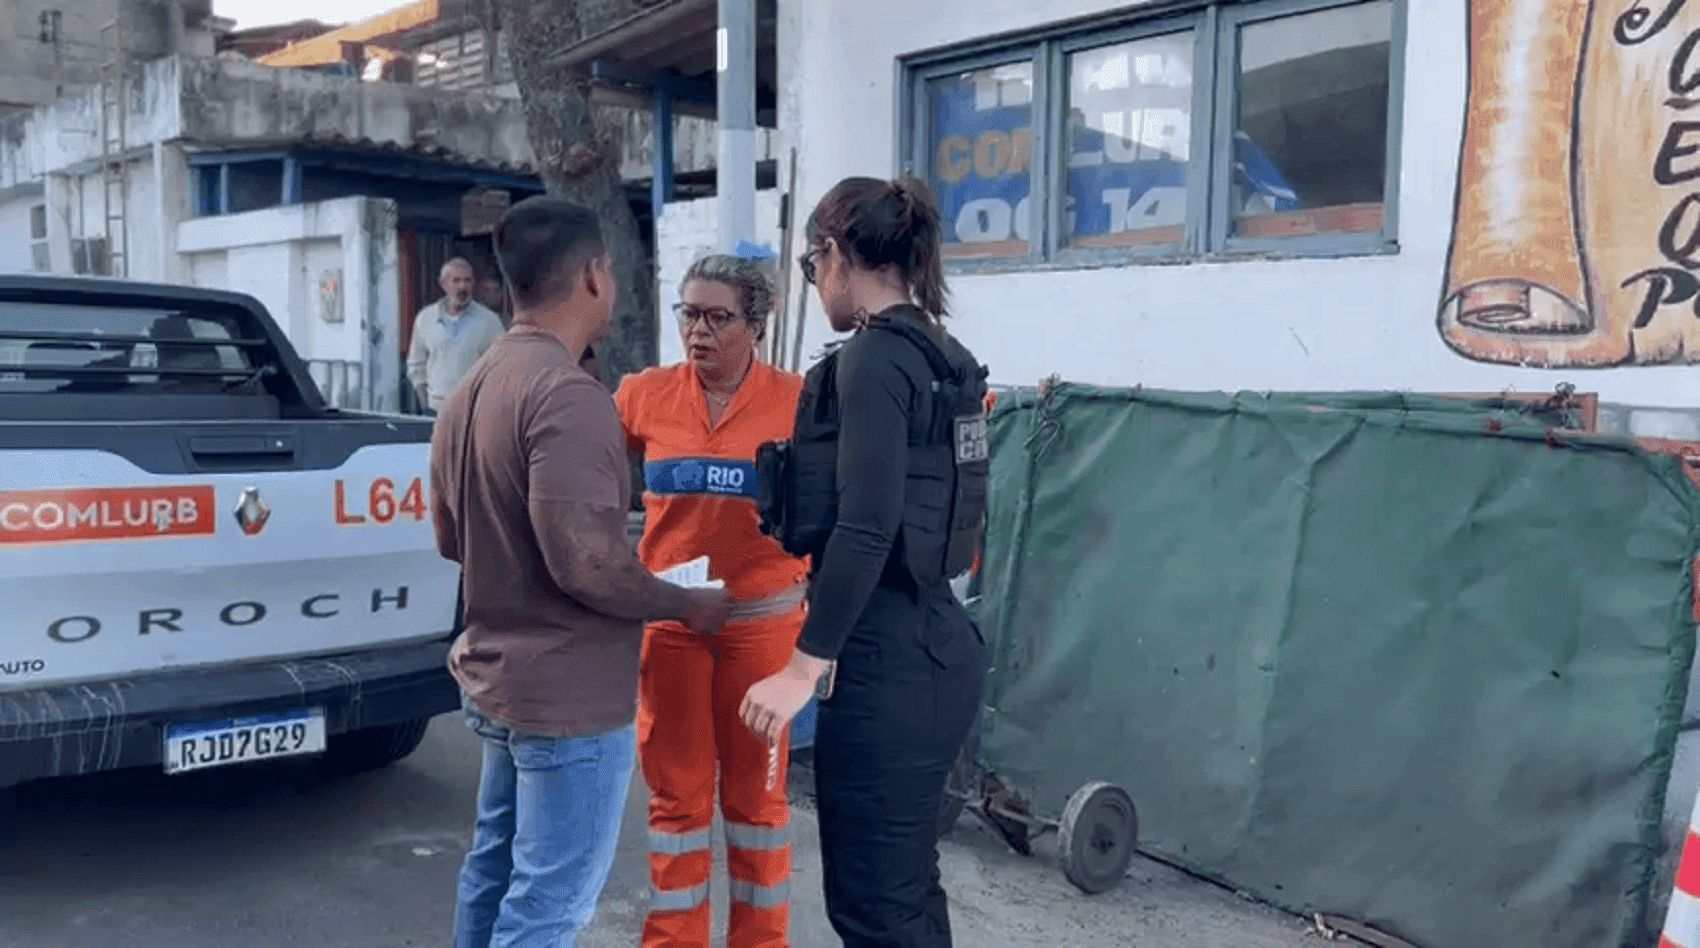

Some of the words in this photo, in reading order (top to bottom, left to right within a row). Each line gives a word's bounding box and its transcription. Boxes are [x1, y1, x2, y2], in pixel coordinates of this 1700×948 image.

[707, 465, 744, 487] RIO
[0, 498, 198, 530] COMLURB
[335, 478, 427, 524] L64
[47, 586, 409, 643] OROCH
